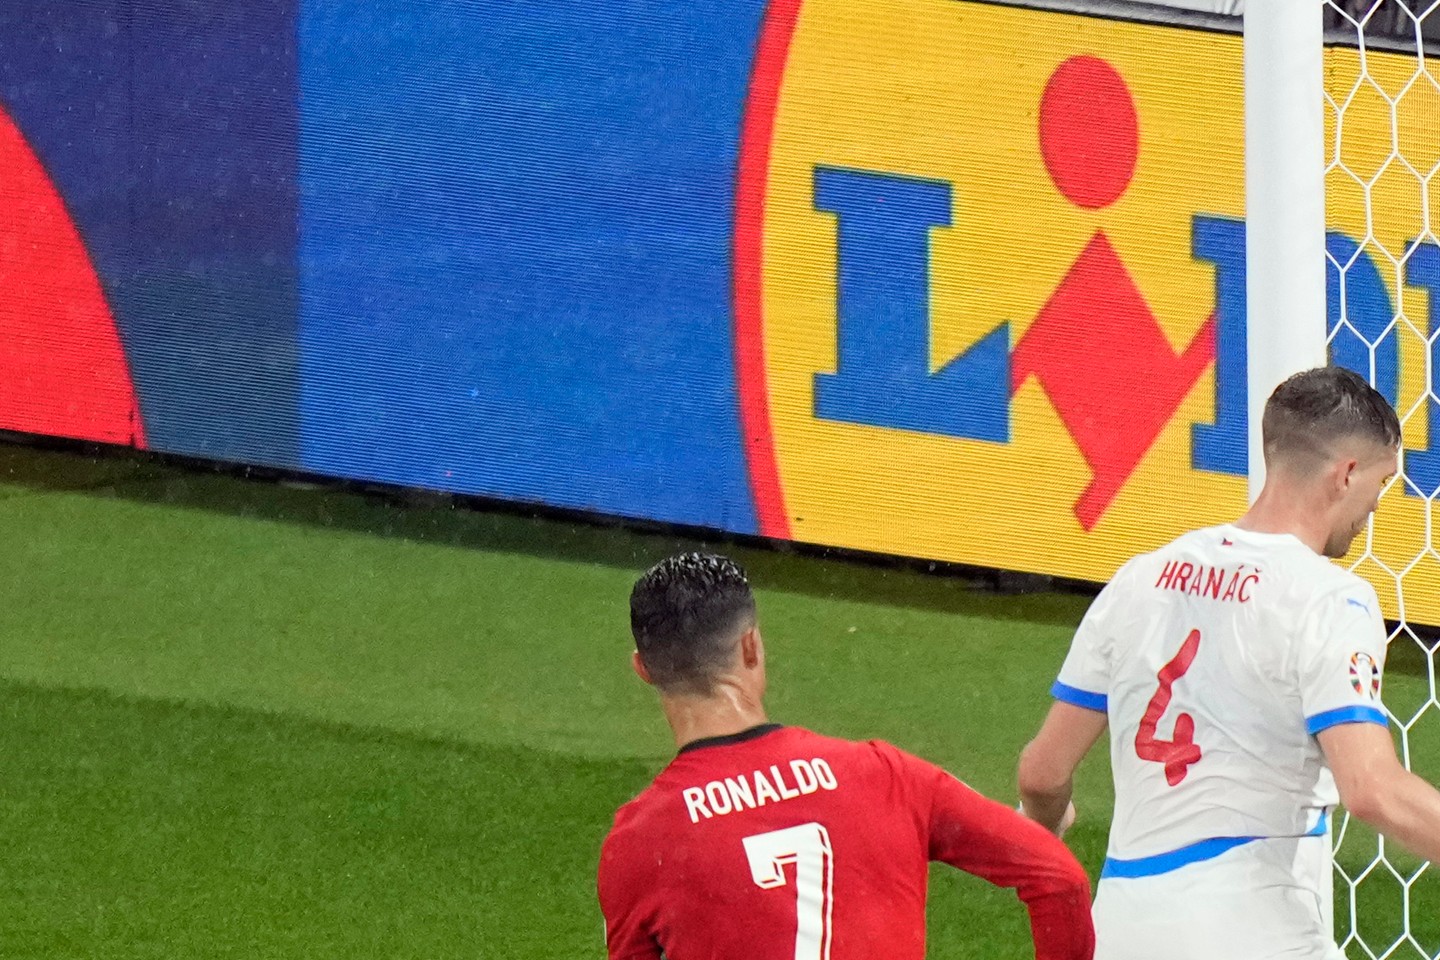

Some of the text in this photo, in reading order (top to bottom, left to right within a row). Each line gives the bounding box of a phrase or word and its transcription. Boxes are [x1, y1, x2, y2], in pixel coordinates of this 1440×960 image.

[1155, 561, 1263, 602] HRANÁČ
[1134, 628, 1202, 787] 4
[683, 757, 838, 823] RONALDO
